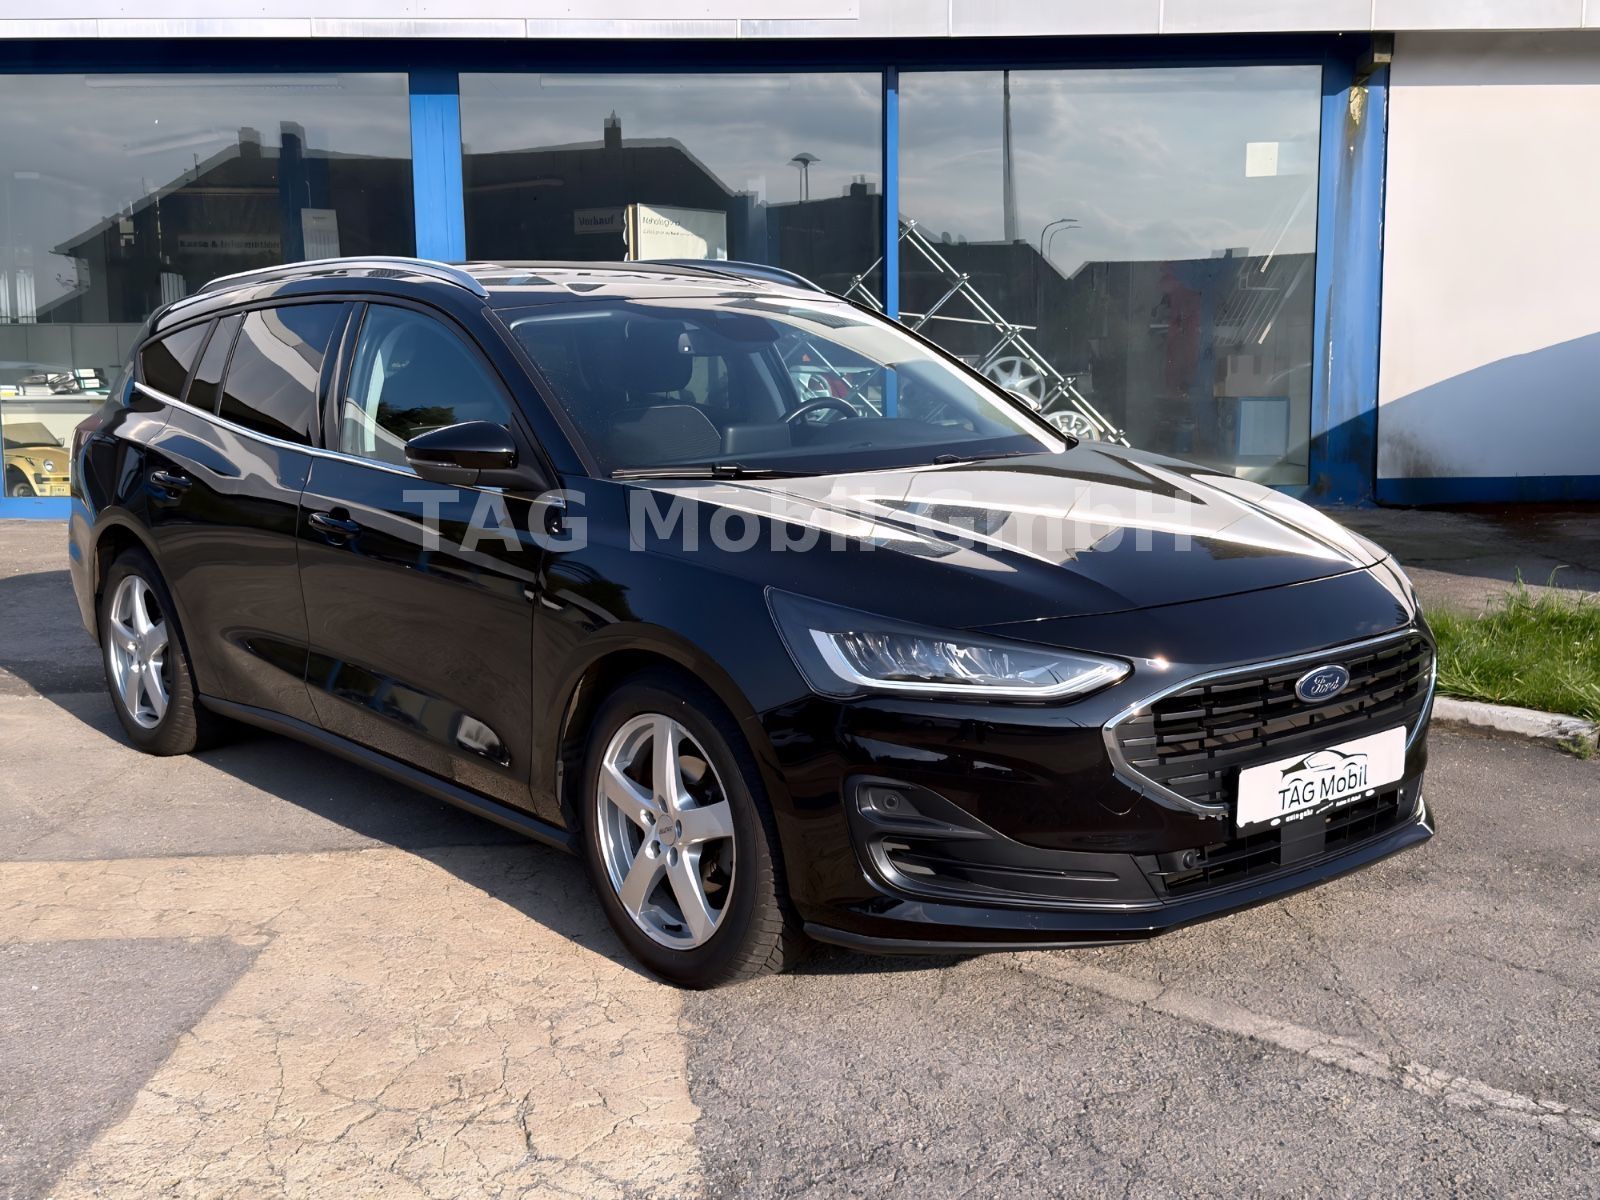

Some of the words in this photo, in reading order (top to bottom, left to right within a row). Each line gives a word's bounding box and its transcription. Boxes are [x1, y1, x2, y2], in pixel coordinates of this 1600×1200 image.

[1311, 674, 1340, 696] Ford
[1278, 781, 1315, 810] TAG
[1319, 764, 1368, 799] Mobil
